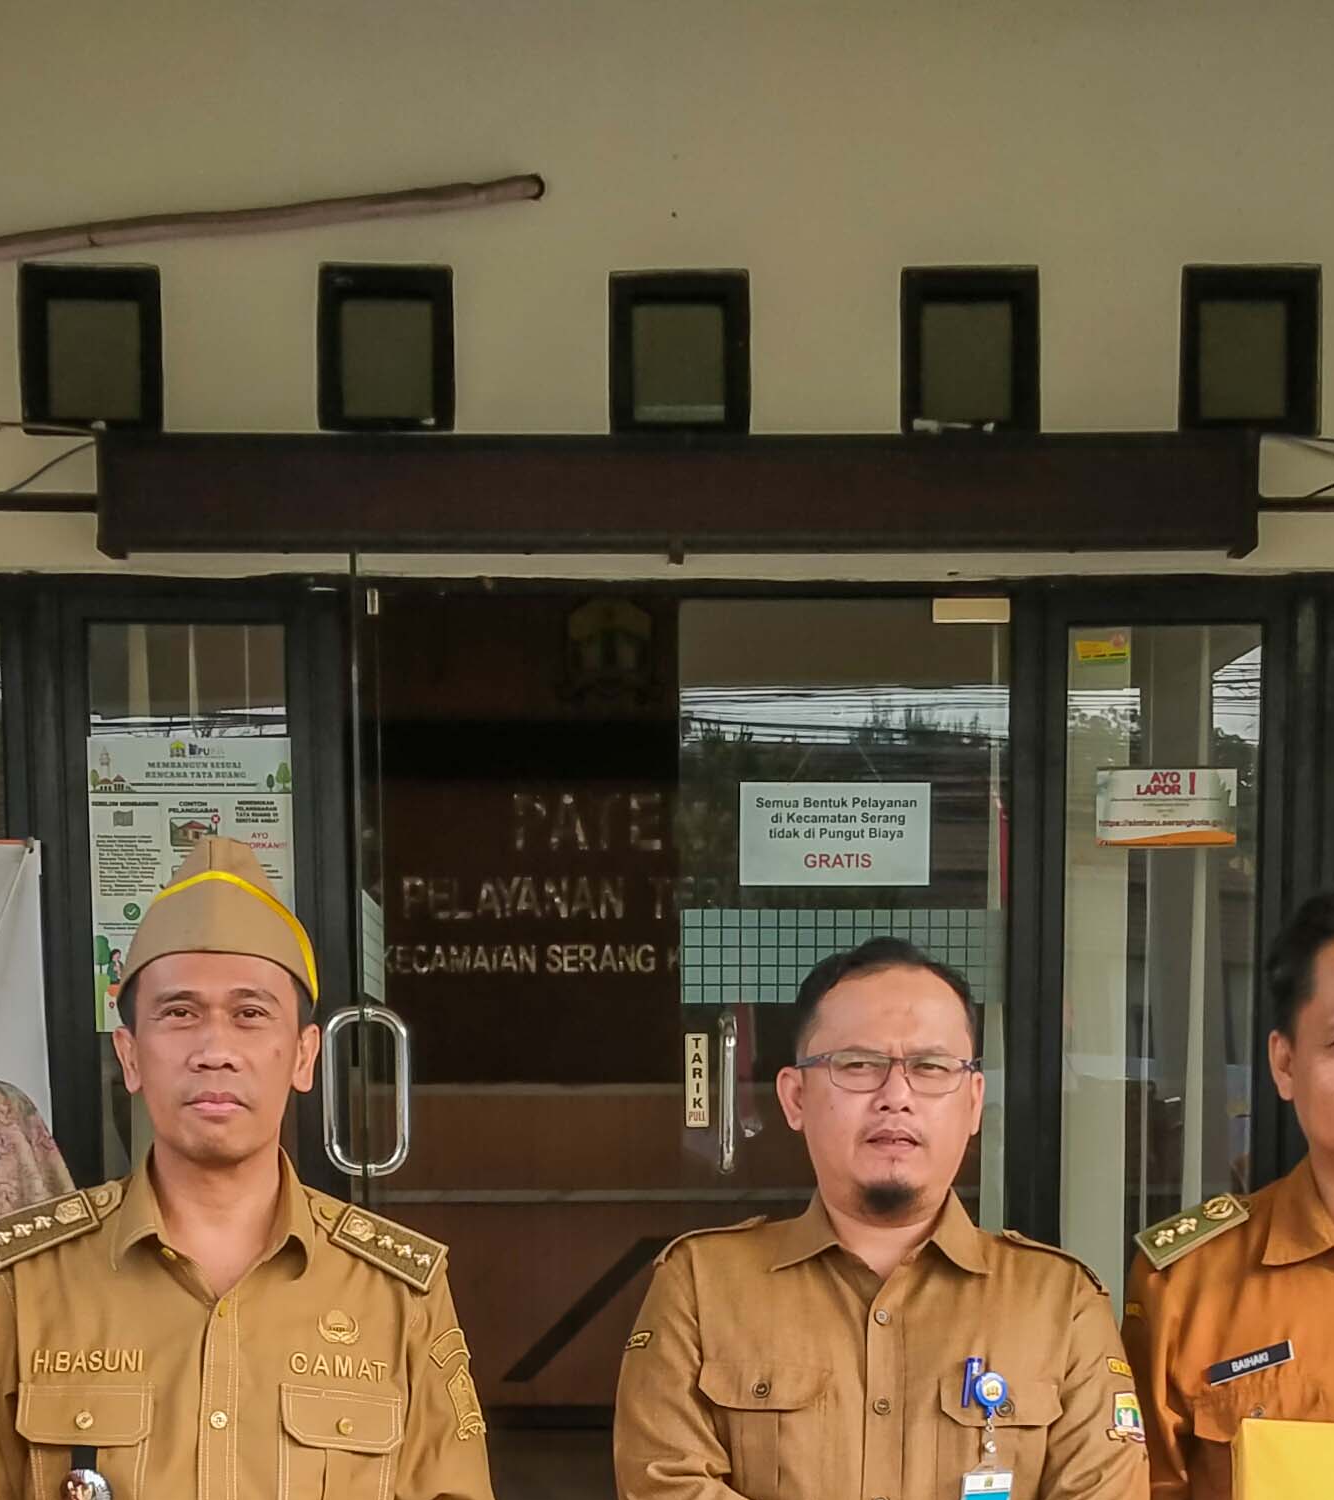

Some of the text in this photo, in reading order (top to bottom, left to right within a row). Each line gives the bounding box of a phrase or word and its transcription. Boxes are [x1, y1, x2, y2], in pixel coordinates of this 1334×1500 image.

[1151, 772, 1181, 784] AYO
[1136, 784, 1181, 796] LAPOR
[755, 797, 918, 811] Semua Bentuk Pelayanan
[513, 793, 663, 850] PATE
[771, 812, 906, 826] di Kecamatan Serang
[769, 827, 904, 841] tidak di Pungut Biaya
[803, 853, 873, 868] GRATIS
[402, 876, 624, 919] PELAYANAN
[546, 943, 656, 974] SERANG
[691, 1036, 704, 1109] TARIK
[688, 1110, 706, 1122] PULL
[32, 1349, 144, 1374] H.BASUNI
[289, 1352, 388, 1383] CAMAT
[1230, 1351, 1270, 1373] BAIHAKI
